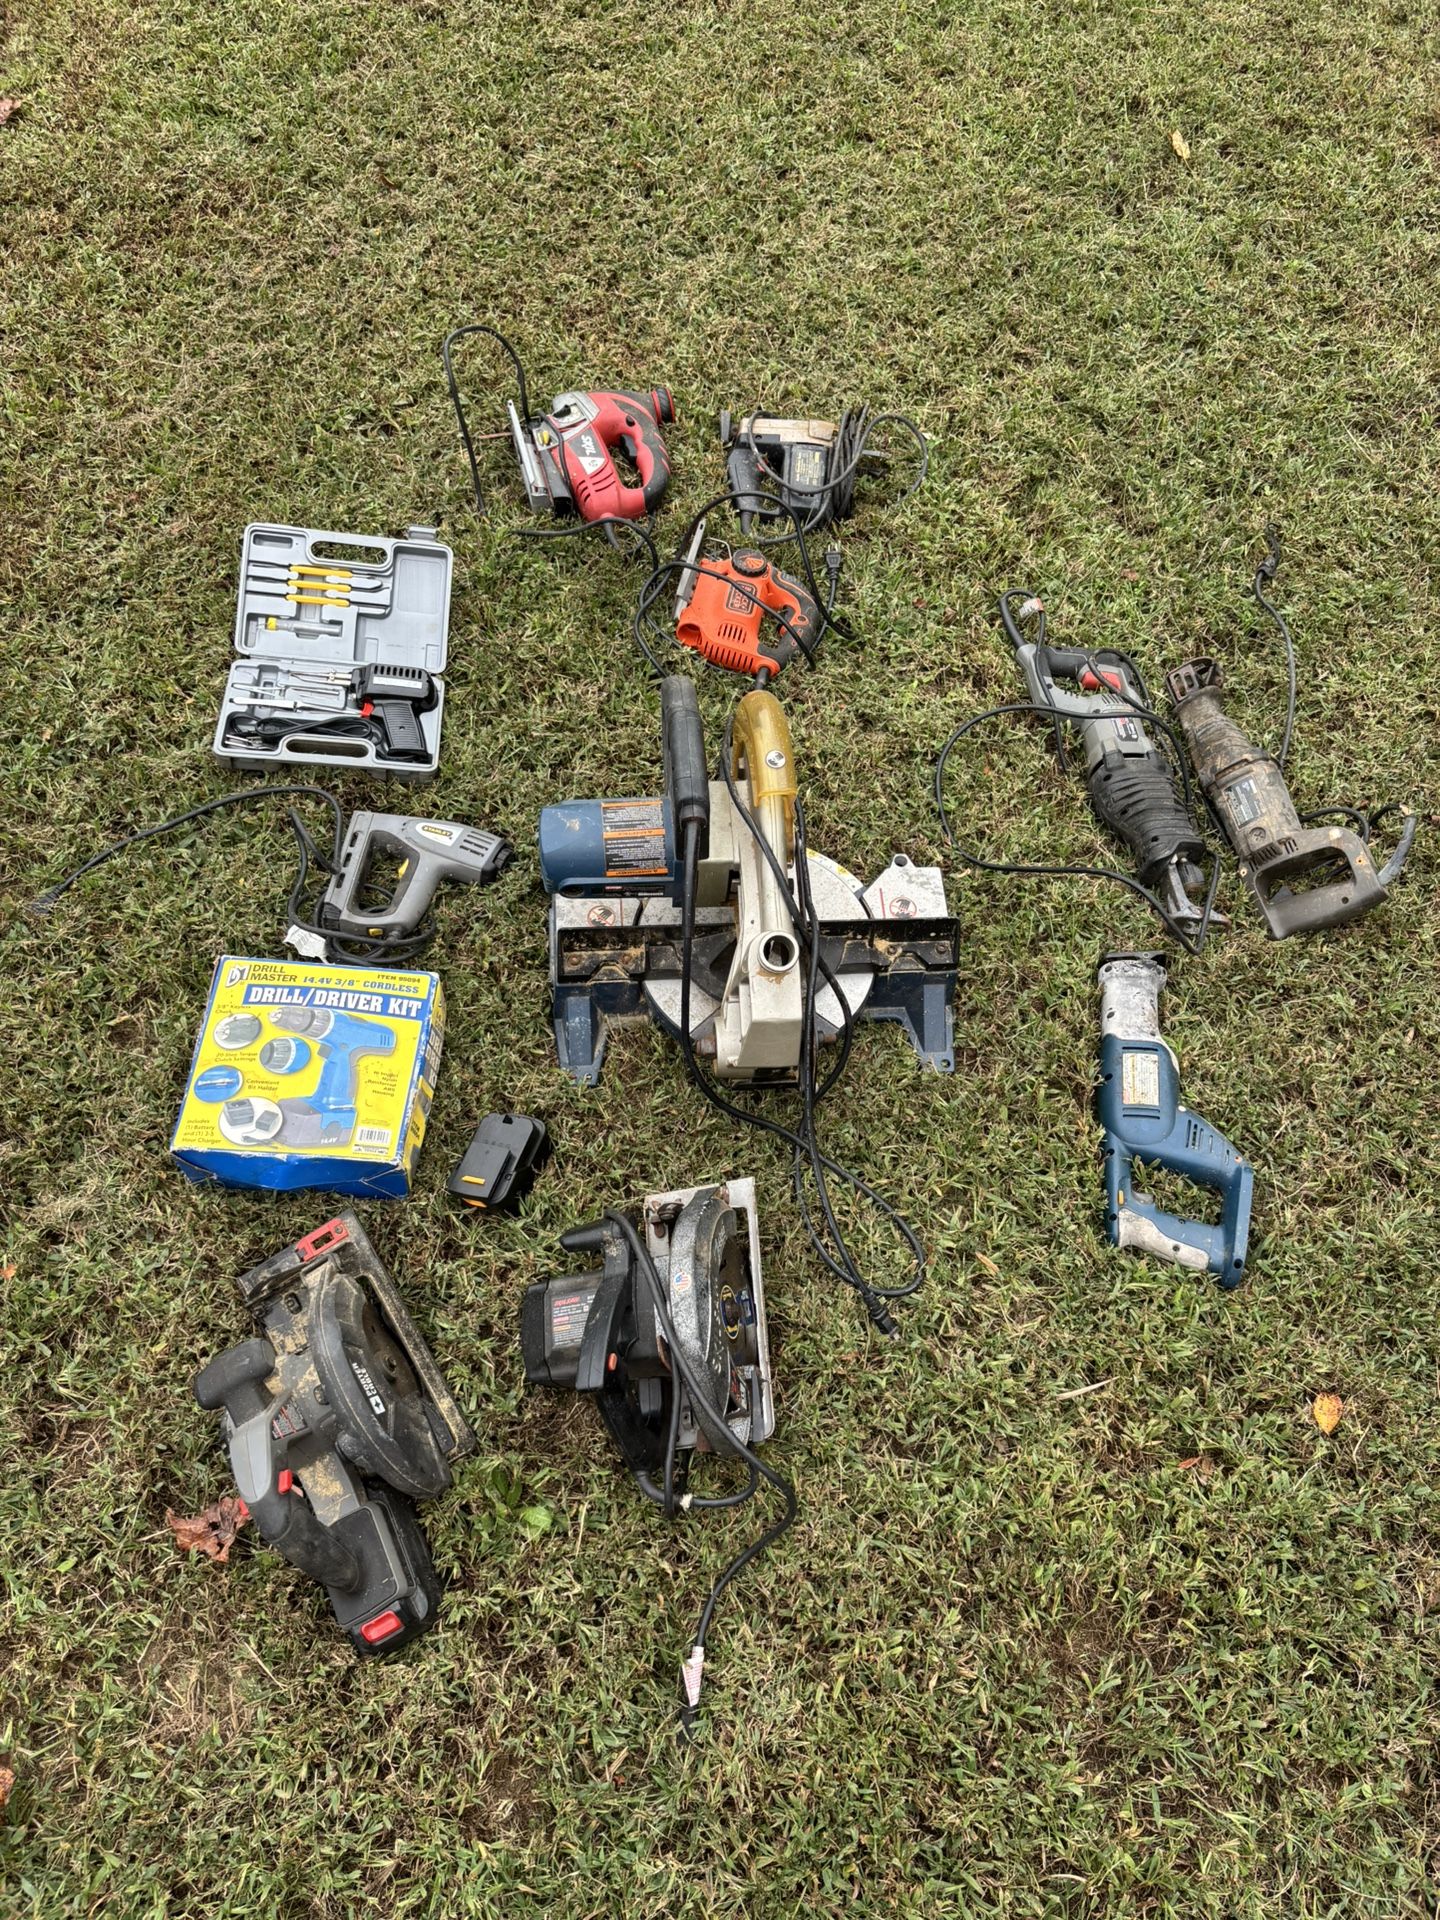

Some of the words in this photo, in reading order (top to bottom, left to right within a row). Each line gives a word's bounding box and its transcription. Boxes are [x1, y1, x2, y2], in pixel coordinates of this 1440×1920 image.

[581, 434, 597, 456] SKIL
[250, 973, 298, 982] MASTER
[252, 964, 286, 973] DRILL
[303, 976, 333, 985] 14.4V
[363, 980, 420, 994] CORDLESS
[248, 986, 383, 1013] DRILL/DRIVER
[387, 997, 422, 1017] KIT
[352, 1362, 373, 1397] PORTER
[360, 1367, 377, 1395] CABLE
